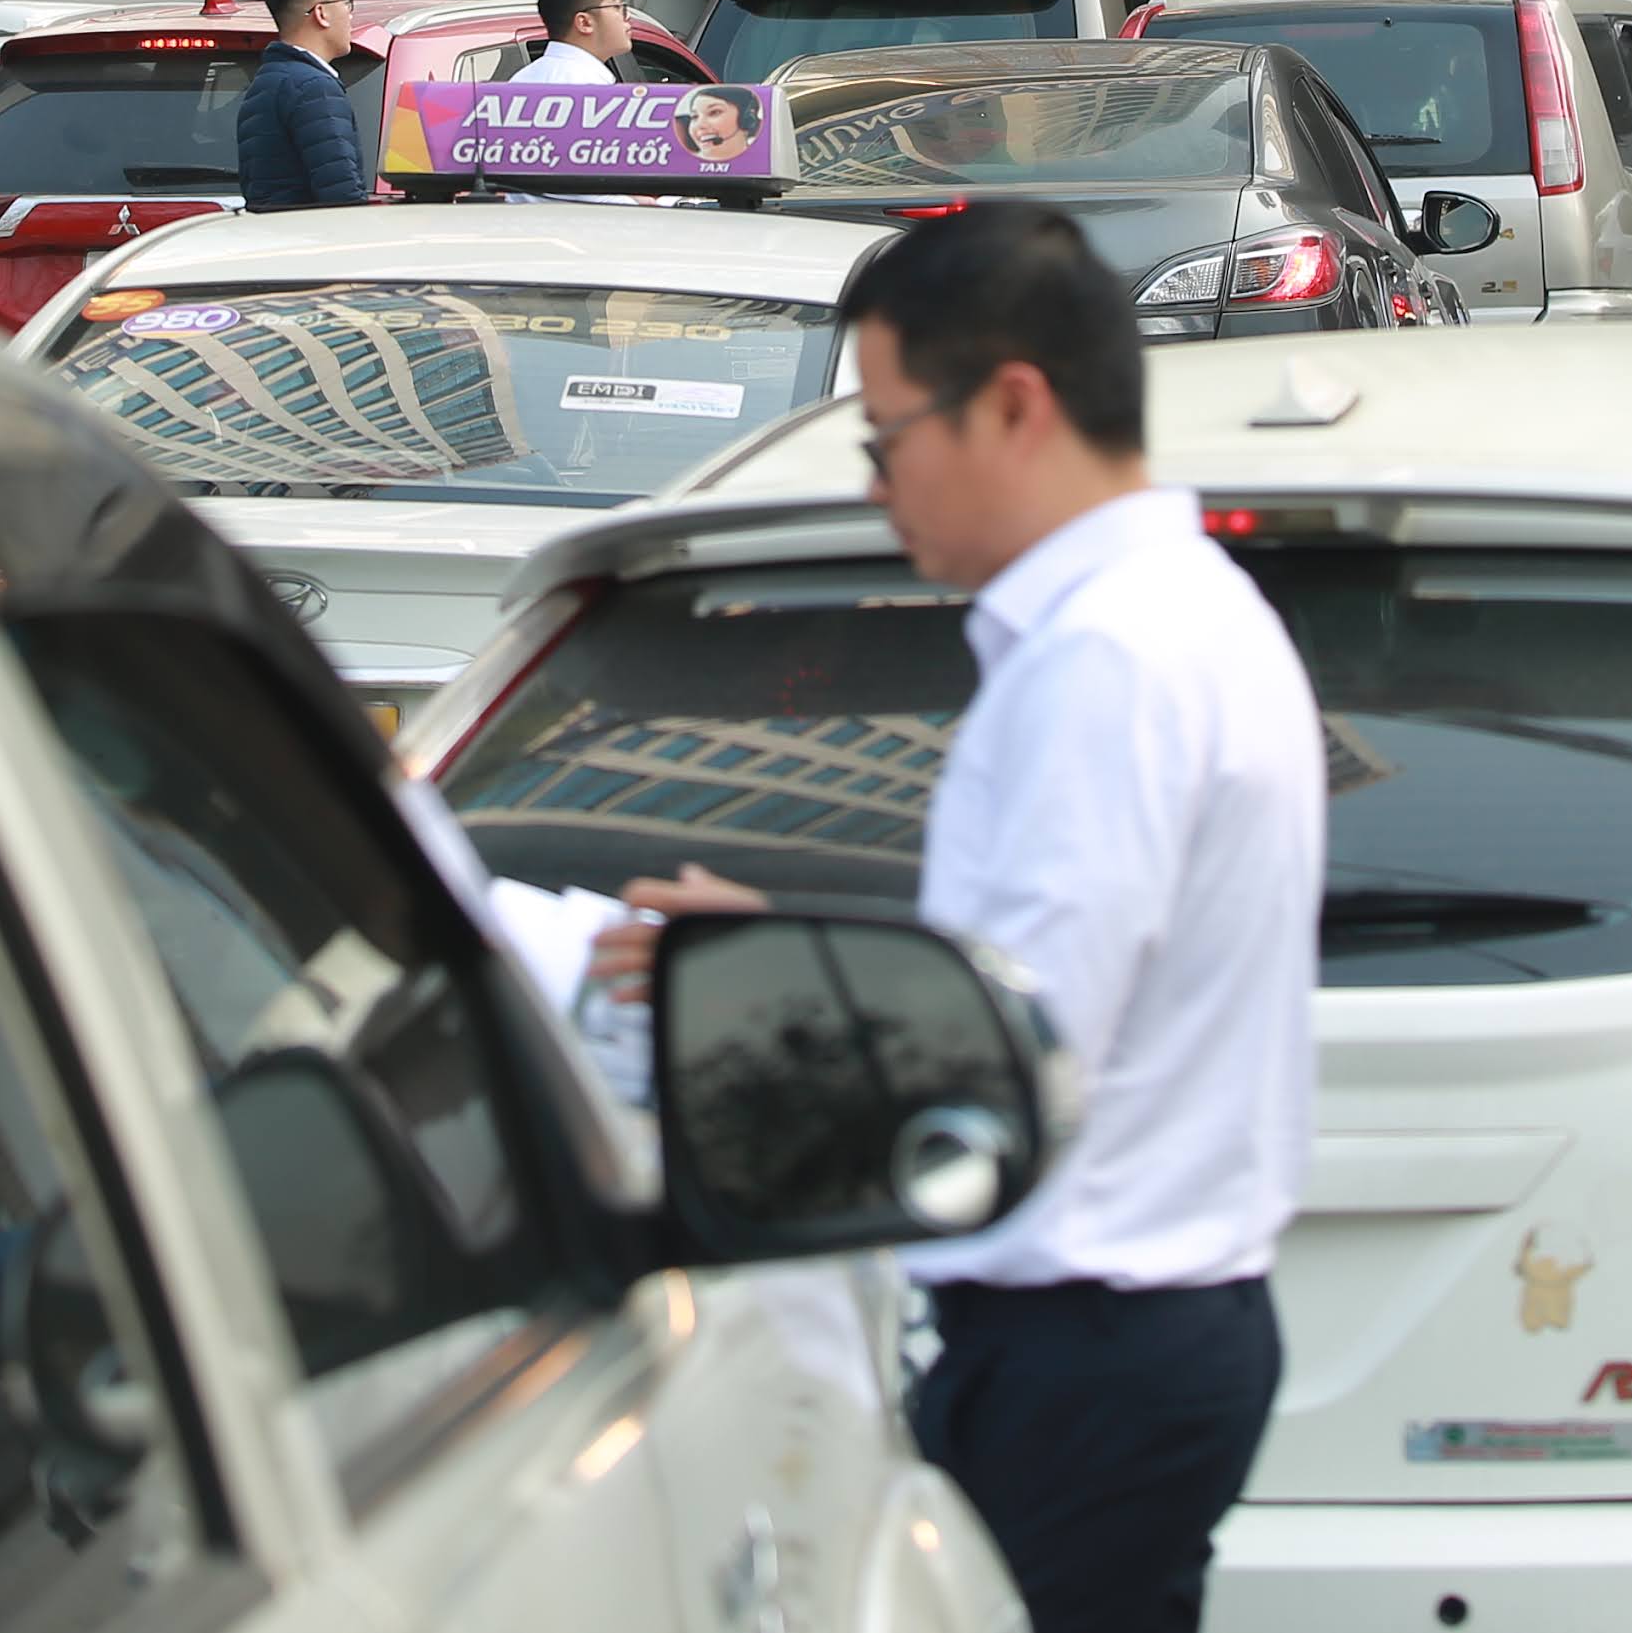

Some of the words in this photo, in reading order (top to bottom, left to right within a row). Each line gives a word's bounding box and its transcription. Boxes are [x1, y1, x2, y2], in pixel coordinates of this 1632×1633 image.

[462, 95, 573, 129] ALO
[453, 138, 503, 164] Giá
[510, 135, 560, 167] tốt,
[569, 138, 619, 165] Giá
[626, 135, 672, 165] tốt
[698, 162, 730, 173] TAXI
[129, 308, 233, 330] 980
